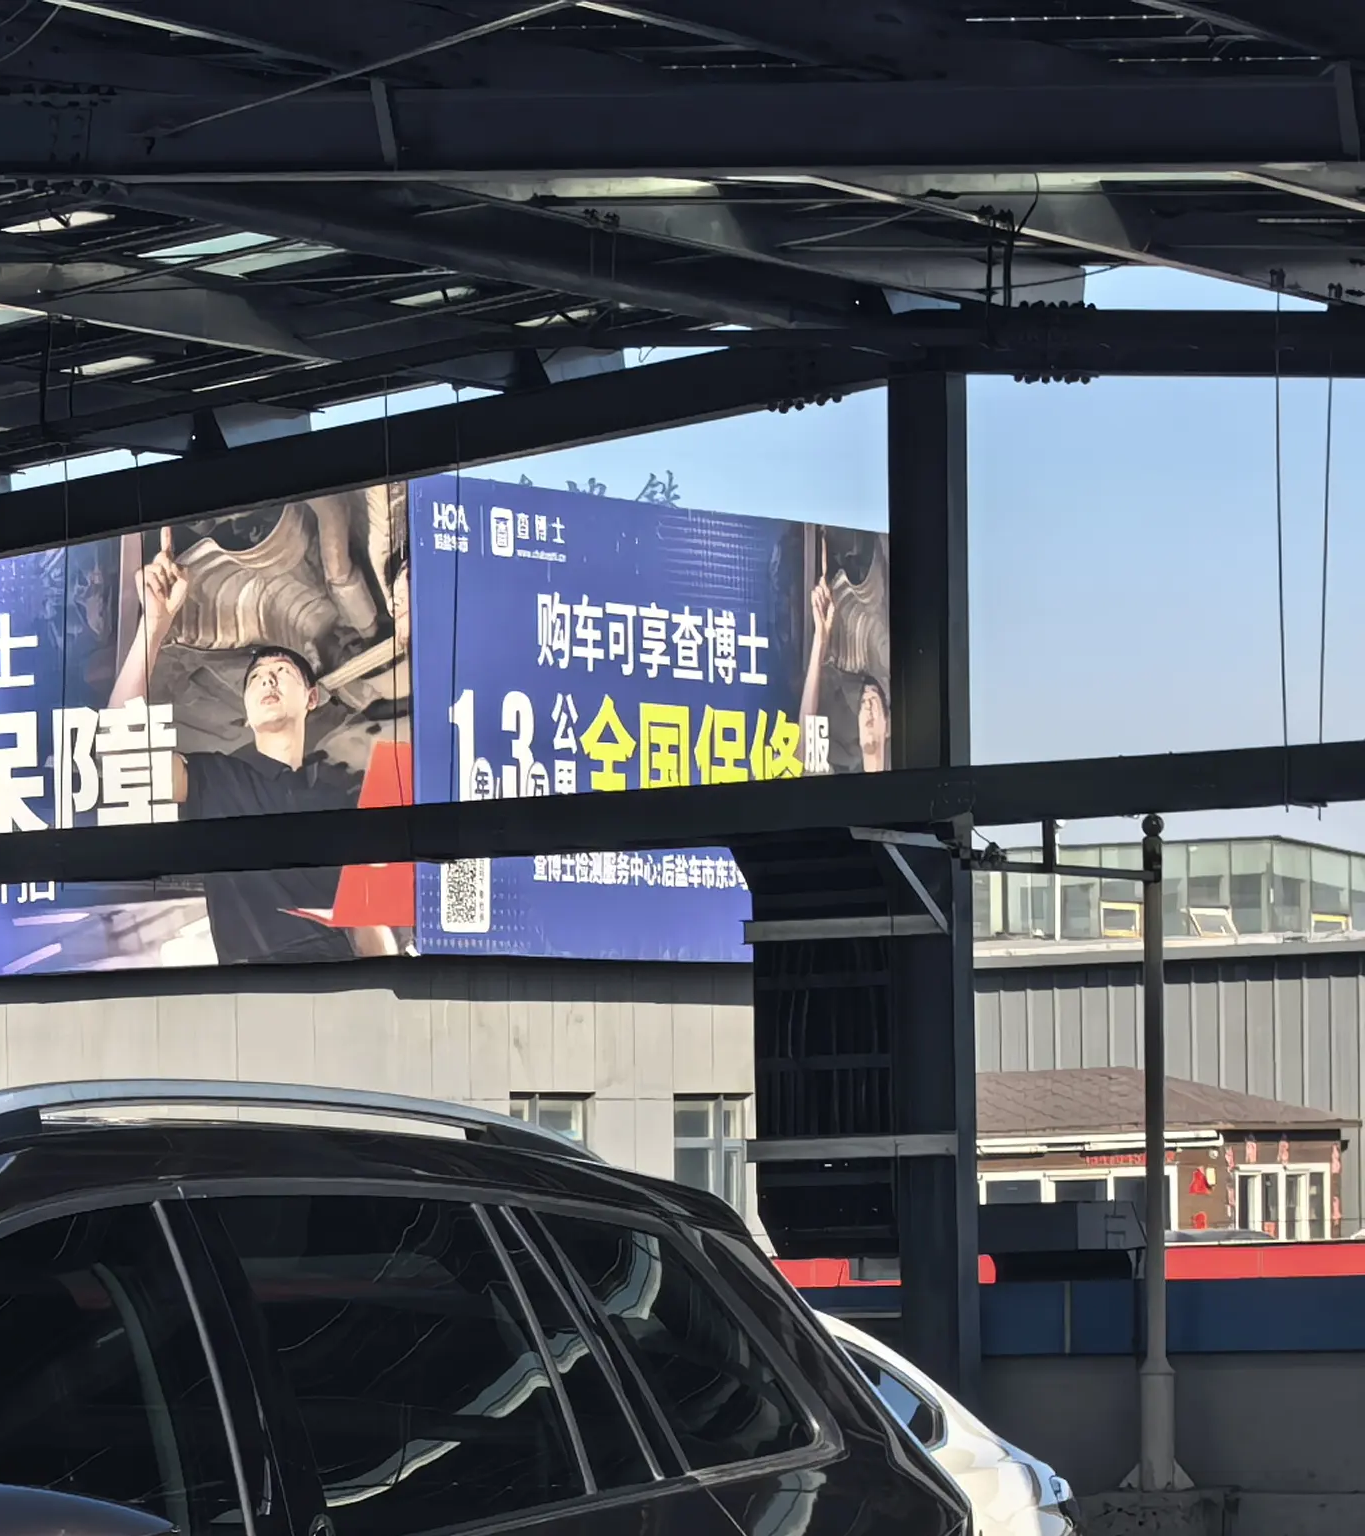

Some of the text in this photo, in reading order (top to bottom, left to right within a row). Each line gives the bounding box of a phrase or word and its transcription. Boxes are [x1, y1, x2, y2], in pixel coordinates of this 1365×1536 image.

[432, 501, 469, 533] HOA
[516, 512, 566, 545] 查博士
[537, 591, 770, 685] 购车可享查博士
